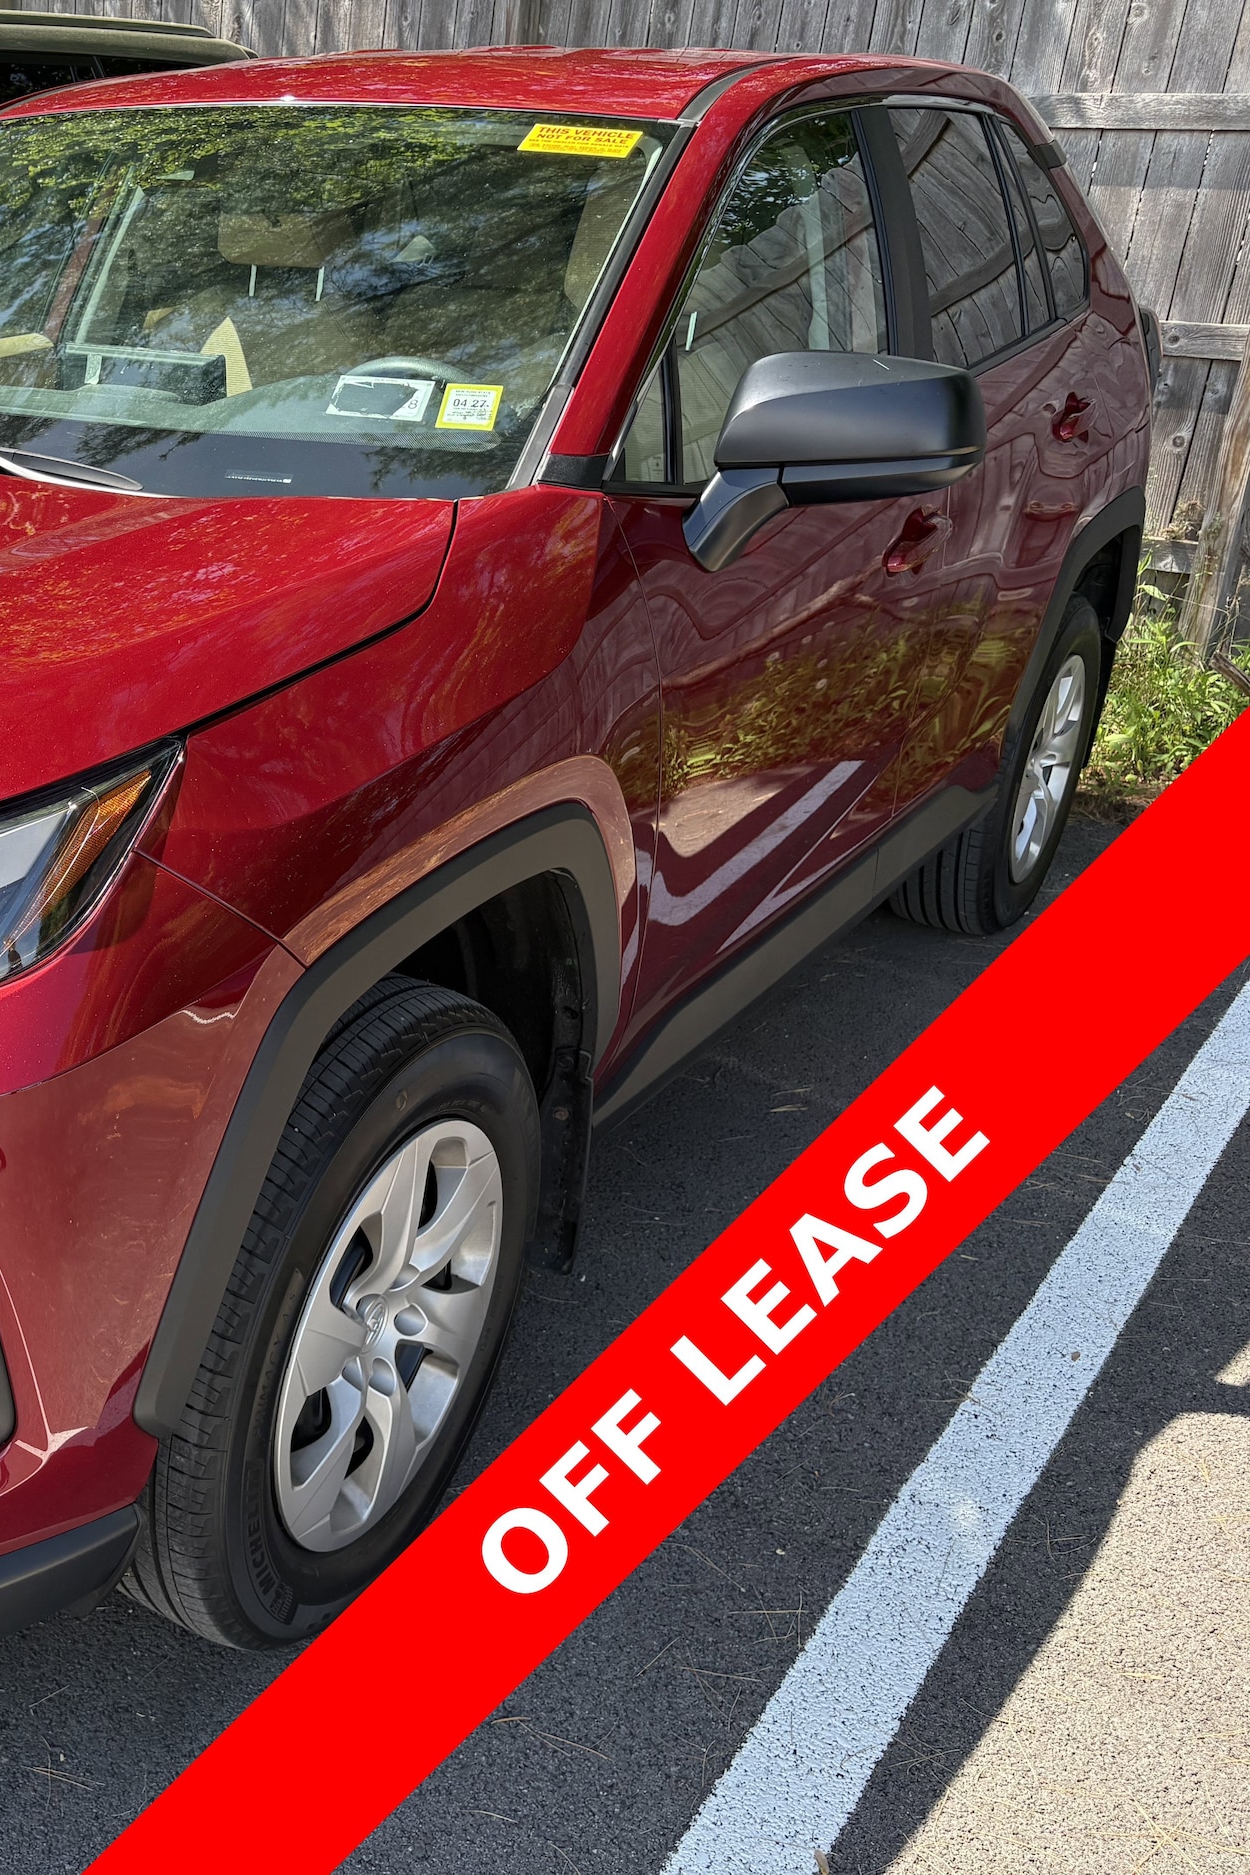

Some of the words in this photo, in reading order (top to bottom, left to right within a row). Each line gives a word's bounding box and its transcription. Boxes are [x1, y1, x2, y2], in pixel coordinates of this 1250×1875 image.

[539, 126, 570, 135] THIS
[575, 129, 636, 139] VEHICLE
[595, 137, 629, 145] SALE
[453, 398, 467, 407] 04
[246, 1465, 276, 1597] MICHELIN
